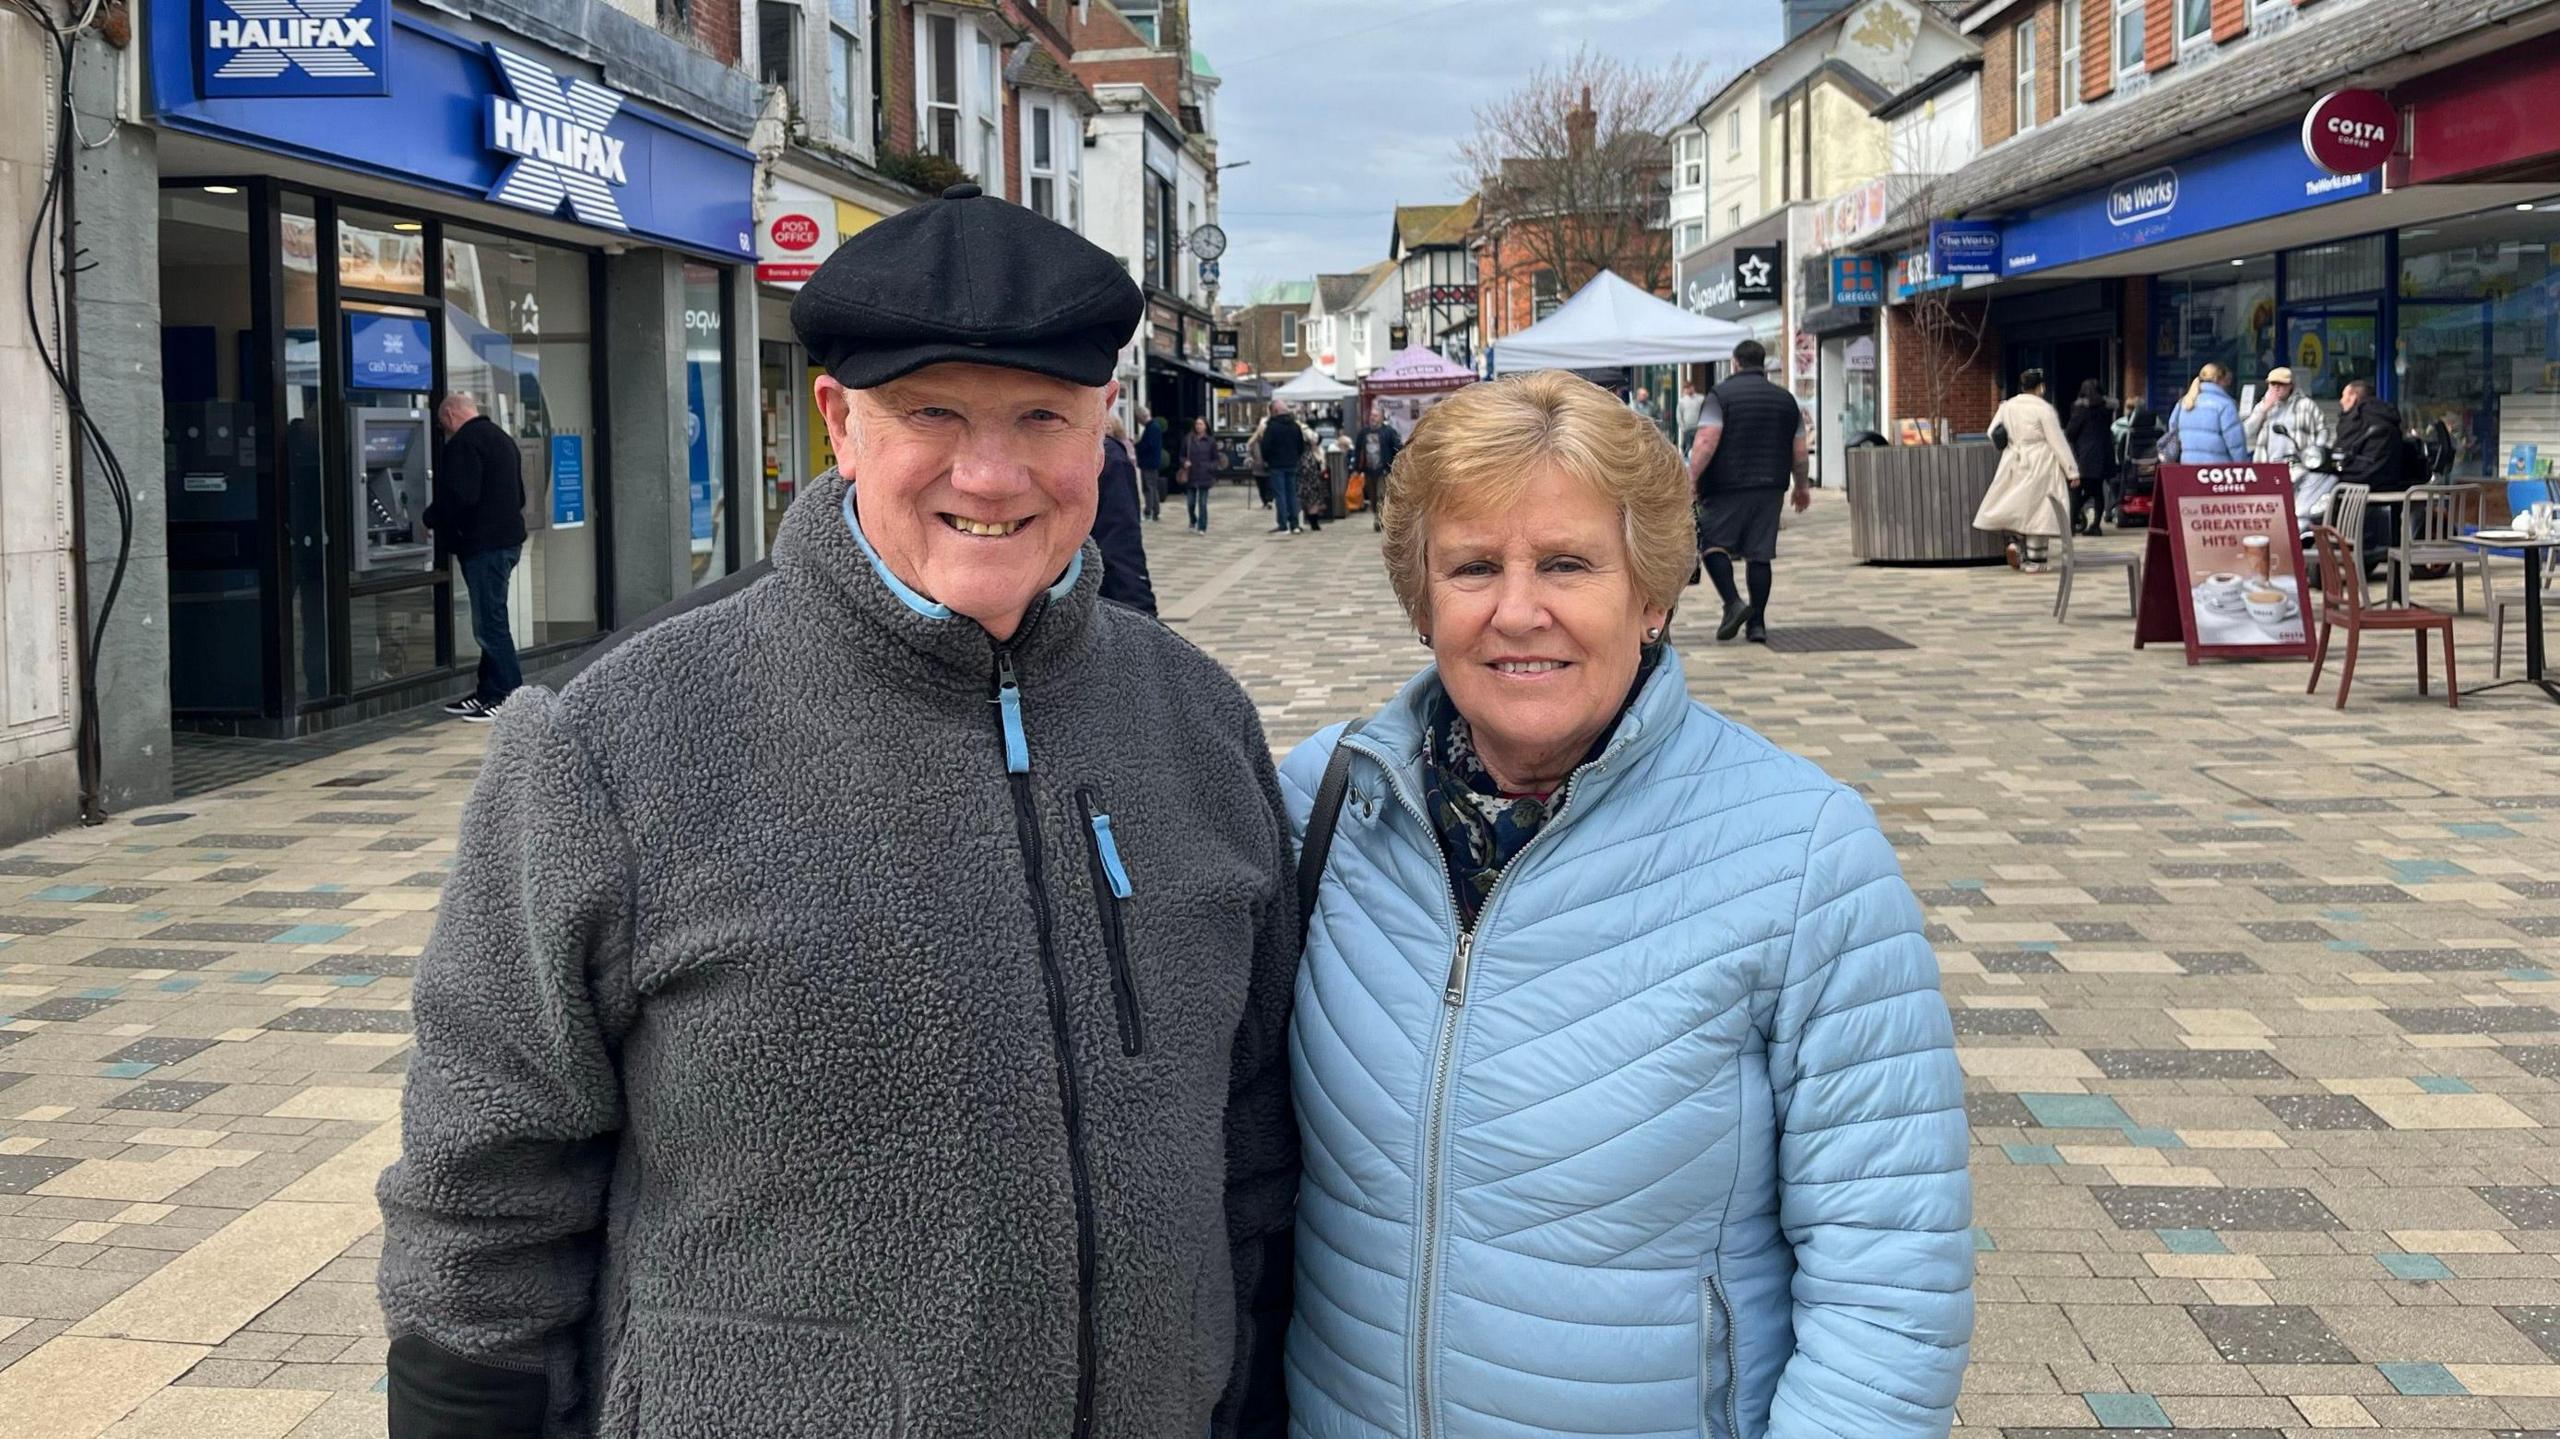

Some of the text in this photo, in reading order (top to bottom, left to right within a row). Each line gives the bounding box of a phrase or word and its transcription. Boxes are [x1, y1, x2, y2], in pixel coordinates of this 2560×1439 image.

[209, 18, 375, 48] HALIFAX
[2328, 117, 2384, 142] COSTA
[494, 98, 627, 184] HALIFAX
[2113, 179, 2172, 216] The Works
[782, 221, 809, 232] POST
[739, 231, 750, 252] 68
[775, 232, 815, 242] OFFICE
[1941, 234, 1994, 245] The Works
[1838, 291, 1879, 302] GREGGS
[368, 360, 418, 374] cash machine
[2197, 467, 2257, 484] COSTA
[2212, 484, 2246, 493] COFFEE
[2201, 503, 2279, 516] BARISTAS'
[2191, 518, 2271, 531] GREATEST
[2202, 535, 2238, 547] HITS
